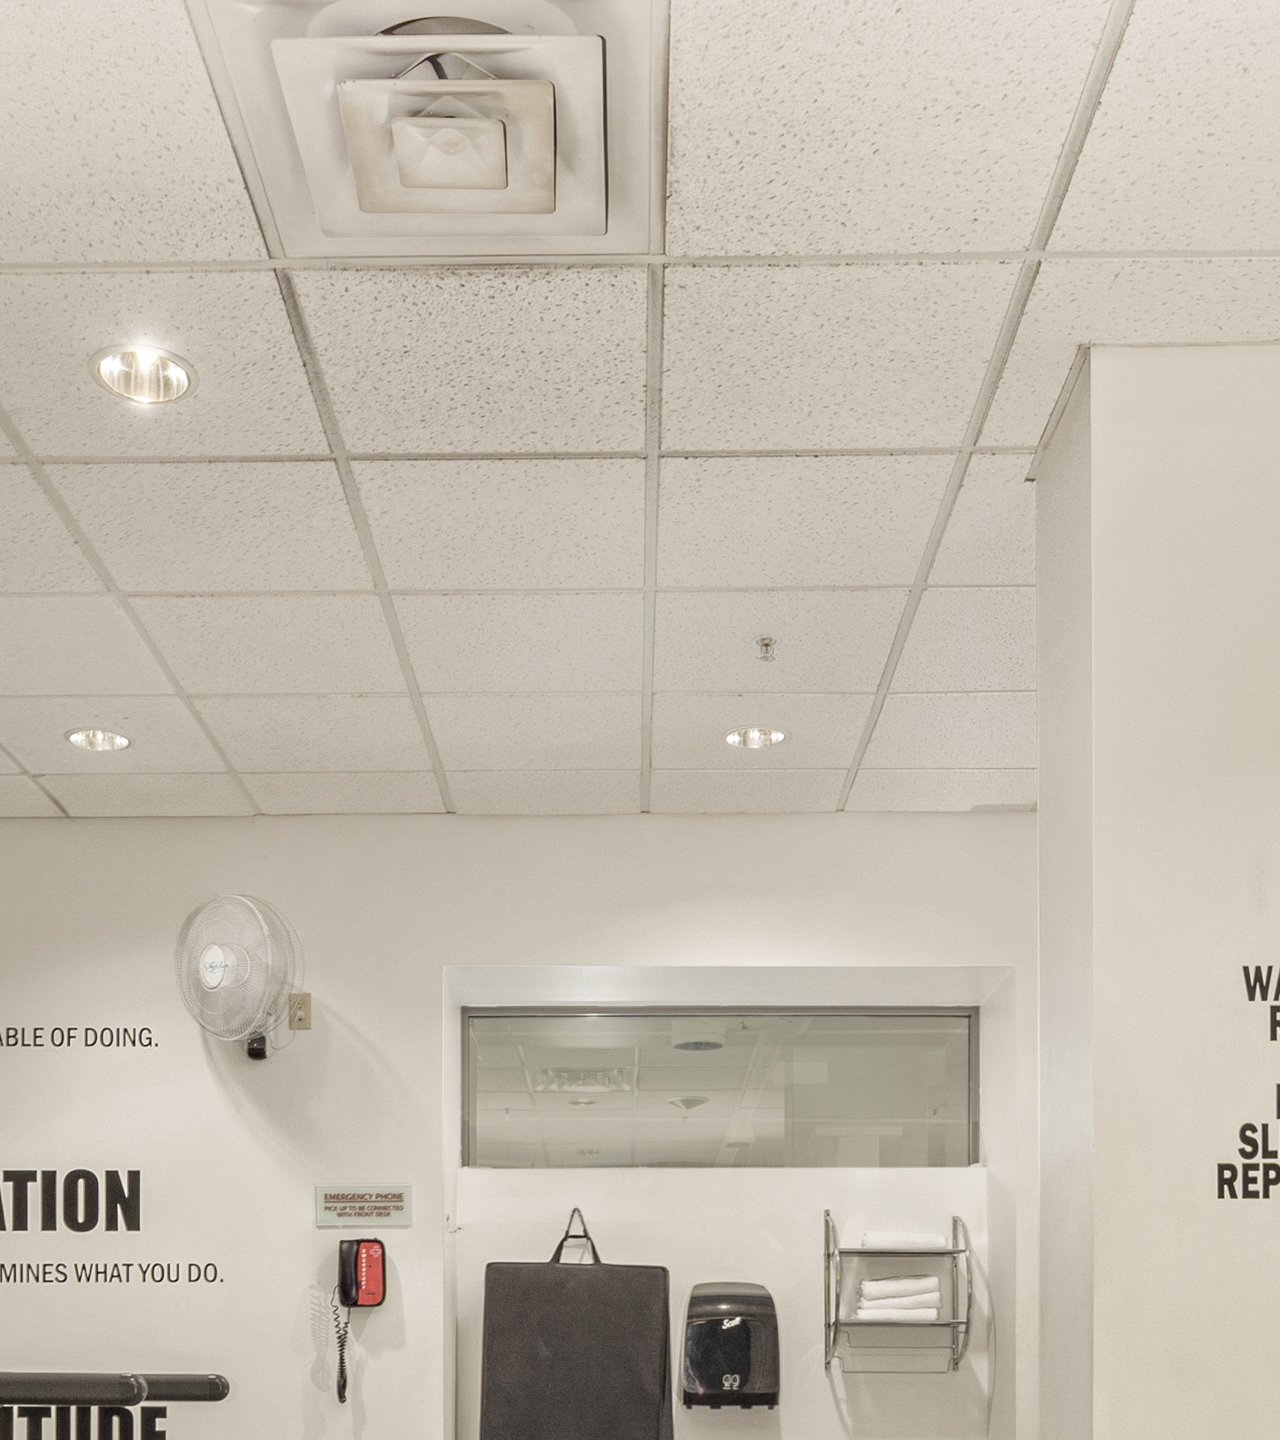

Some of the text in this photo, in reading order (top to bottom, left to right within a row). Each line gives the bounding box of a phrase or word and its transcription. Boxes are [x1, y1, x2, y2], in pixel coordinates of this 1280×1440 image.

[51, 1027, 78, 1047] OF
[85, 1027, 159, 1047] DOING.
[324, 1193, 404, 1201] EMERGENCY PHONE
[74, 1263, 134, 1283] WHAT
[138, 1263, 180, 1283] YOU
[188, 1263, 224, 1283] DO.
